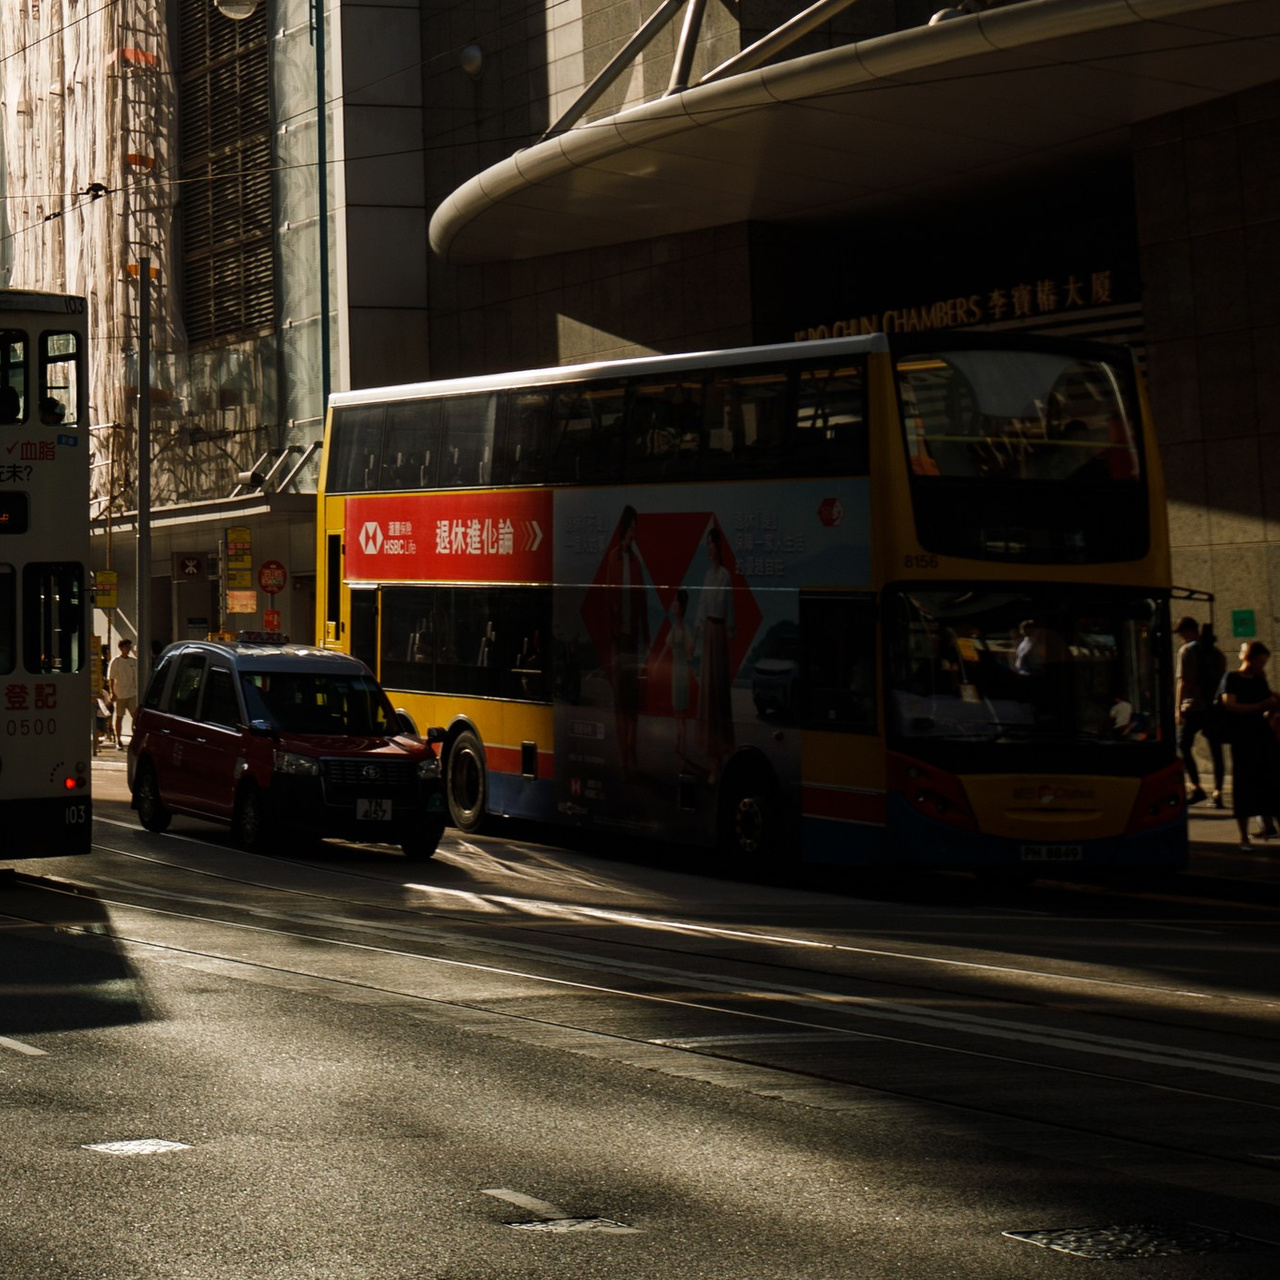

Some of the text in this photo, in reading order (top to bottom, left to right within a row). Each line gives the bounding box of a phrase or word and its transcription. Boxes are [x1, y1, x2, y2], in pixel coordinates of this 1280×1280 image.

[65, 298, 85, 314] 103
[882, 294, 983, 333] CHAMBERS
[20, 441, 56, 461] 血脂
[435, 518, 514, 555] 退休進化論
[383, 539, 405, 554] HSBC
[904, 554, 939, 568] 8156
[5, 683, 57, 711] 登記
[6, 719, 57, 736] 0500
[368, 797, 382, 809] YN
[65, 806, 86, 824] 103
